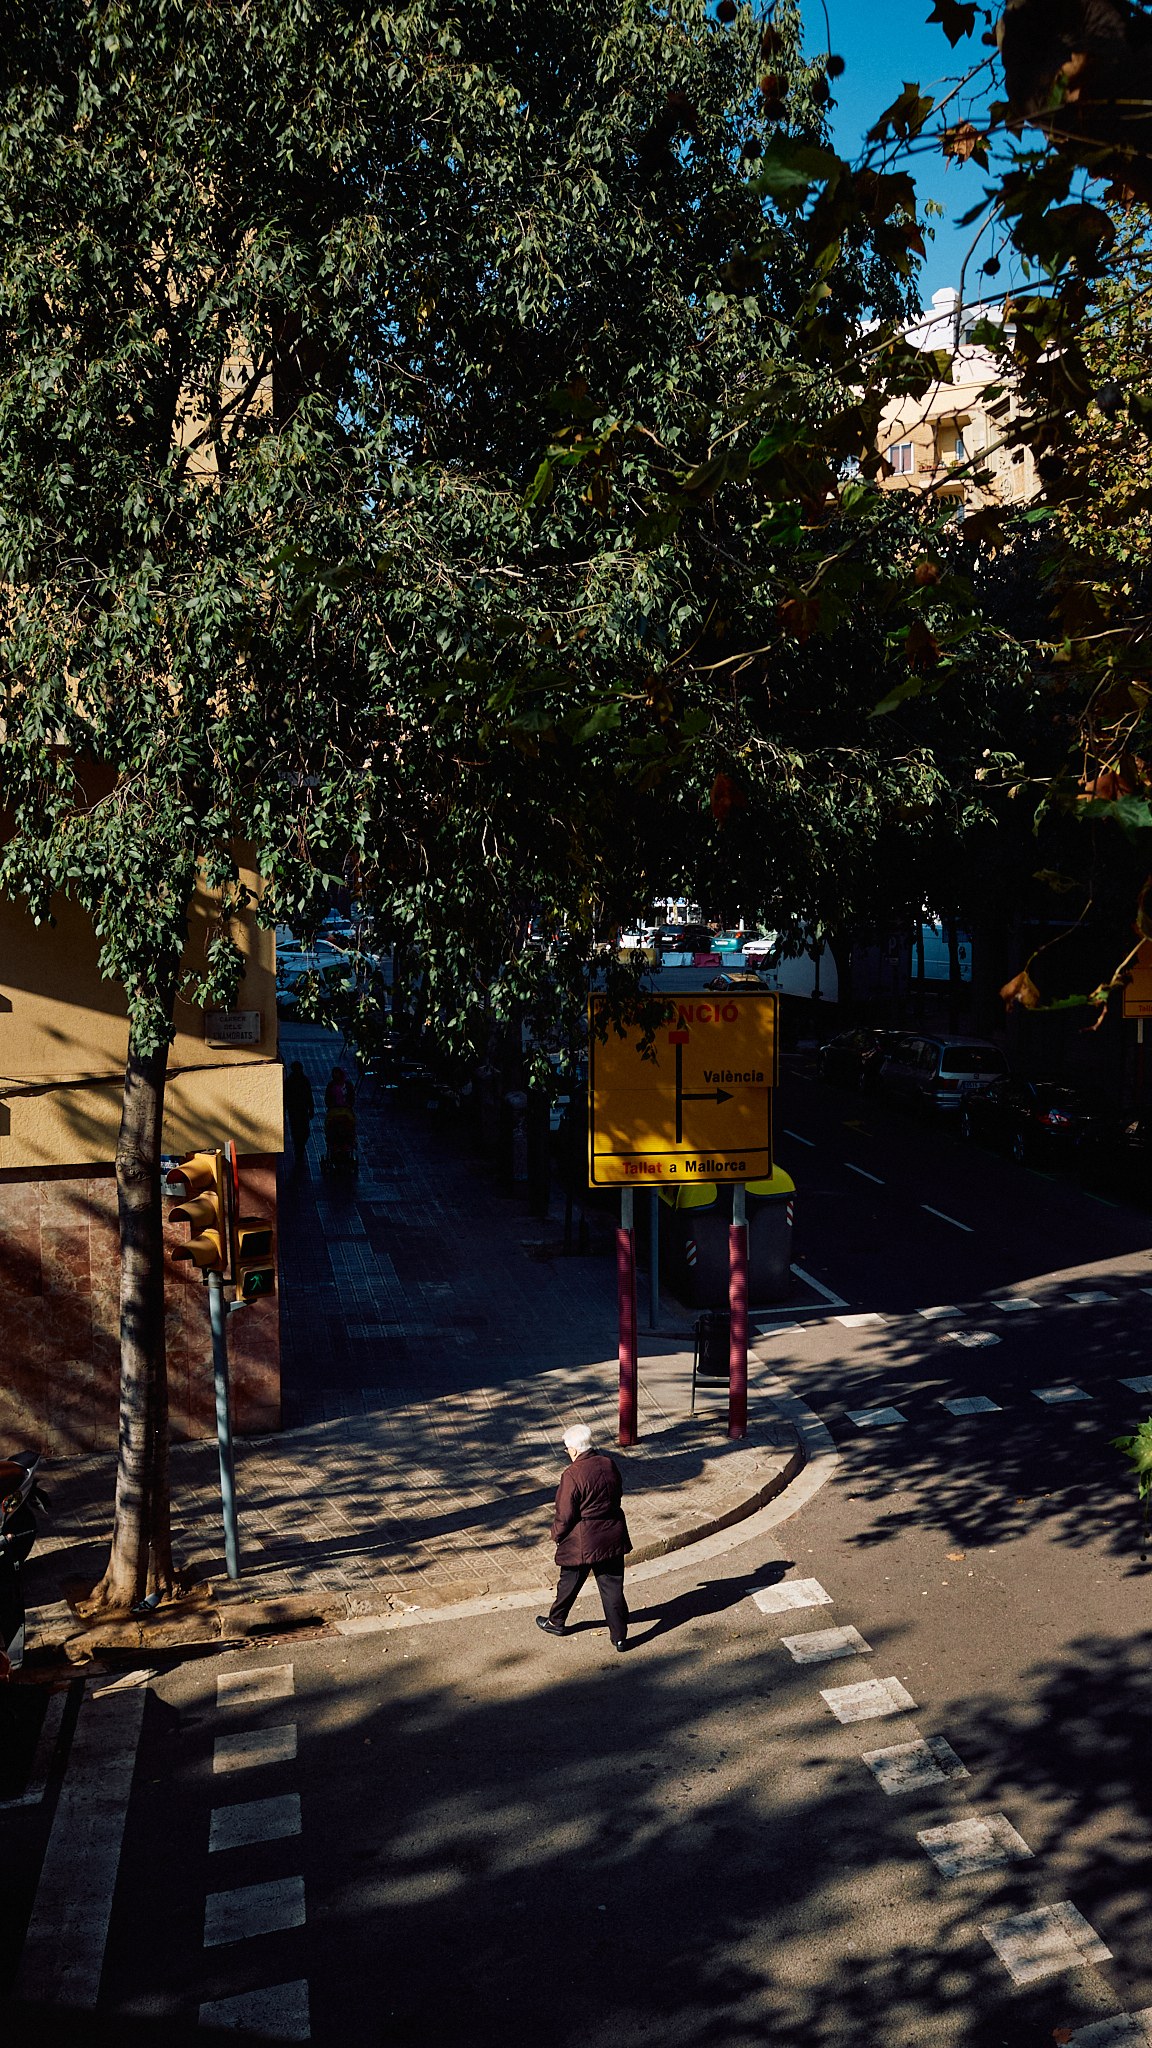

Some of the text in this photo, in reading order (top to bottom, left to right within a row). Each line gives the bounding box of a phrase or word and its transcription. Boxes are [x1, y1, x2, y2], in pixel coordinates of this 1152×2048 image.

[703, 1069, 764, 1083] València
[622, 1160, 747, 1174] Tallat a Mallorca
